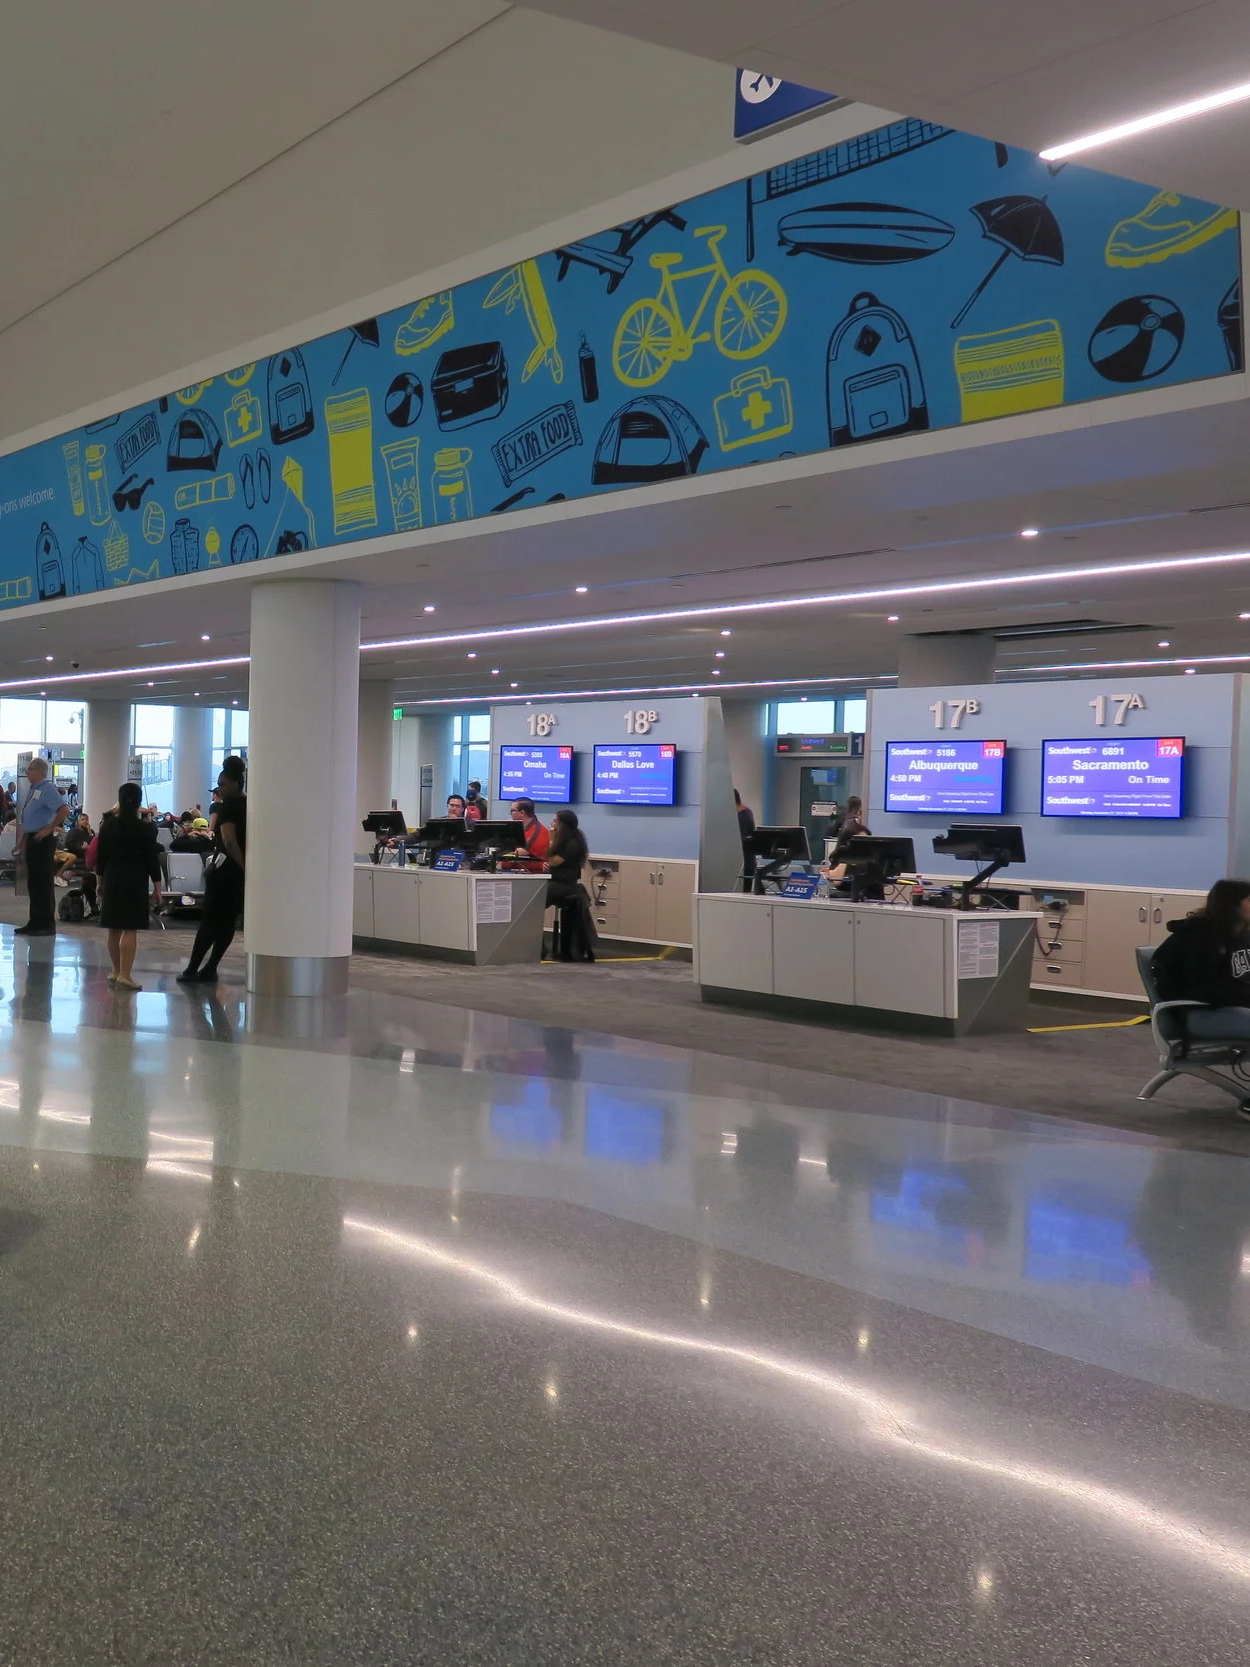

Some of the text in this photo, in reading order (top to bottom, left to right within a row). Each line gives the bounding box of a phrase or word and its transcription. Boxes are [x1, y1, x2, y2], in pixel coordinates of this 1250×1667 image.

[119, 421, 156, 464] EXTRA FOOD
[501, 413, 569, 472] EXTRA FOOD
[928, 699, 980, 729] 17B
[1088, 693, 1146, 726] 17A
[527, 713, 557, 736] 18A
[624, 709, 658, 734] 18B
[891, 748, 956, 757] Southwest 5186
[984, 748, 1001, 757] 17B
[1048, 747, 1124, 756] Southwest 6891
[1159, 746, 1179, 755] 17A
[523, 760, 547, 769] Omaha
[612, 760, 655, 769] Dallas Love
[909, 760, 979, 772] Albuquerque
[1072, 759, 1149, 770] Sacramento
[890, 774, 922, 782] 4:50 PM
[1047, 775, 1084, 784] 5:05 PM
[1128, 775, 1171, 784] On Time
[889, 793, 925, 801] Southwest
[1047, 797, 1089, 805] Southwest
